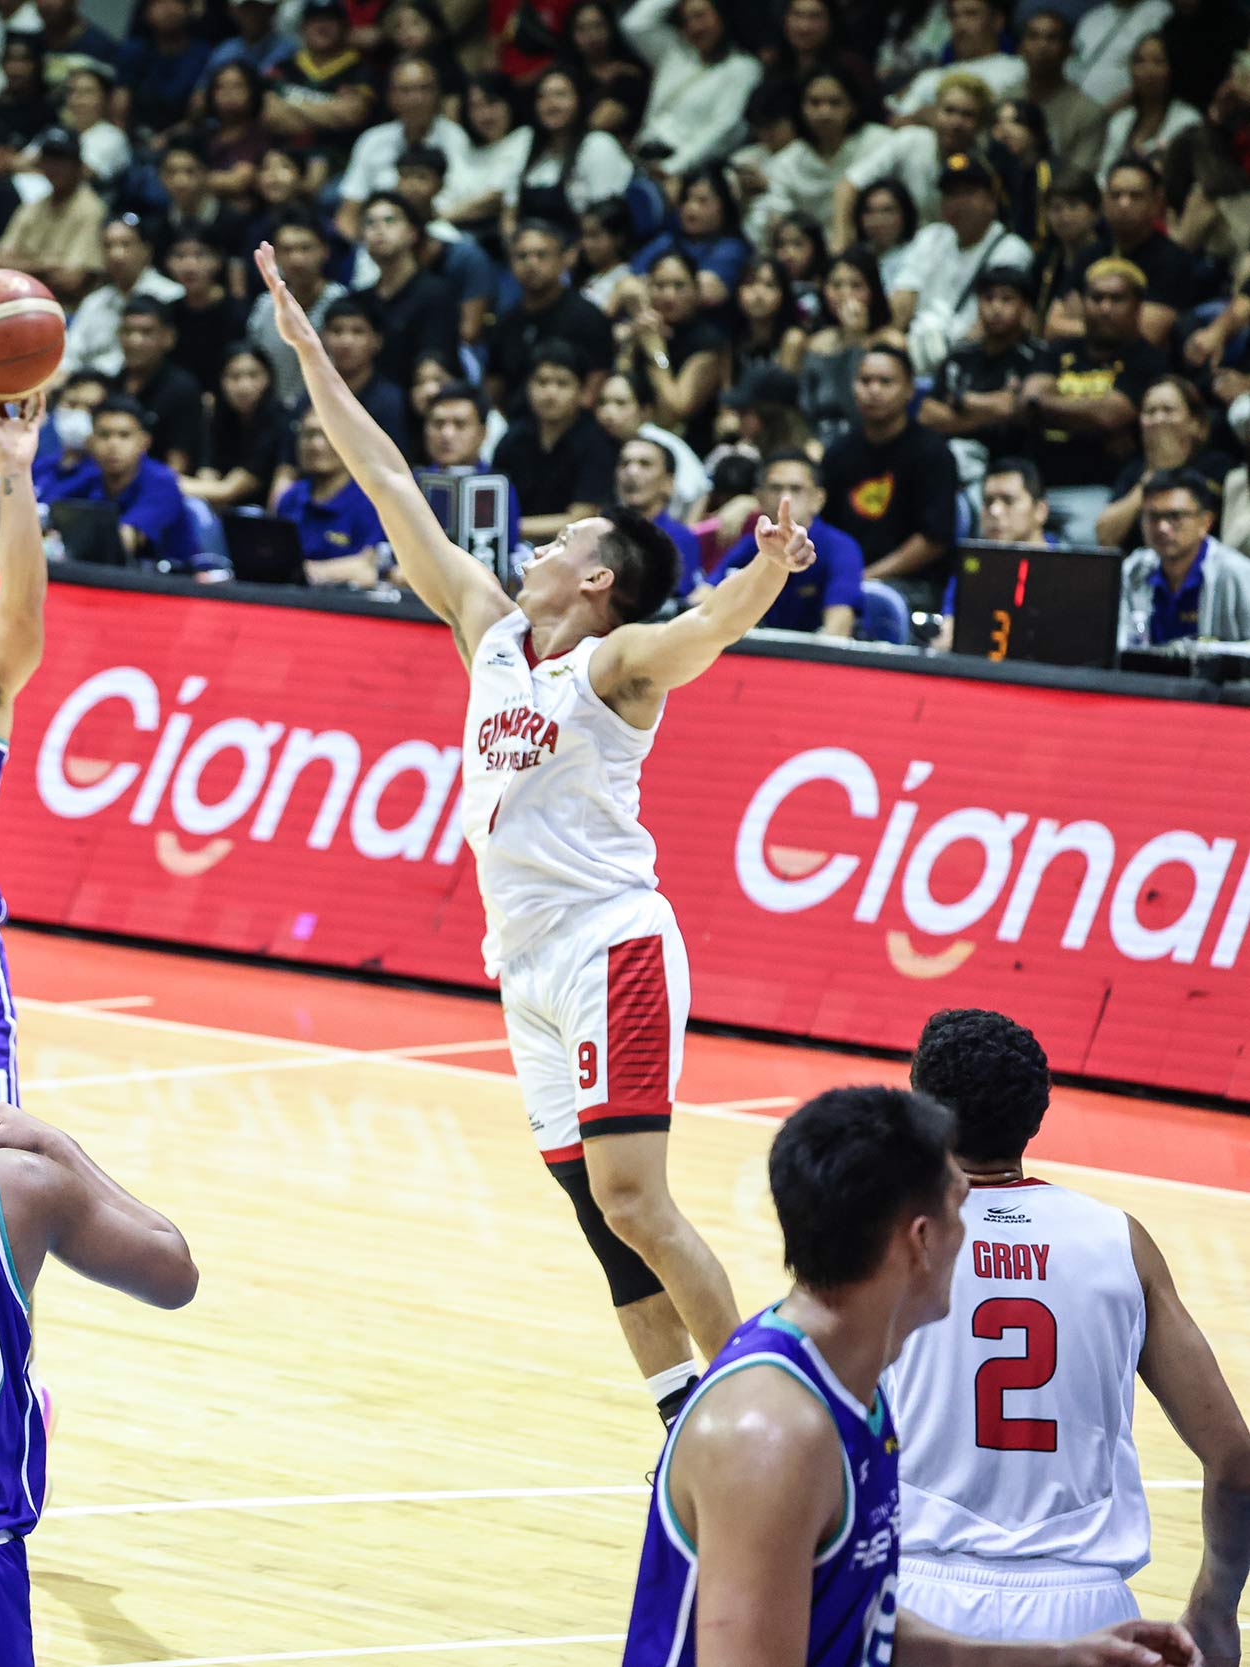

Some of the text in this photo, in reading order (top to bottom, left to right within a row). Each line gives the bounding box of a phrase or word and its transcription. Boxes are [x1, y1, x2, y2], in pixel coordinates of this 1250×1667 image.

[578, 1040, 598, 1090] 9
[972, 1240, 1050, 1281] GRAY
[971, 1297, 1057, 1452] 2
